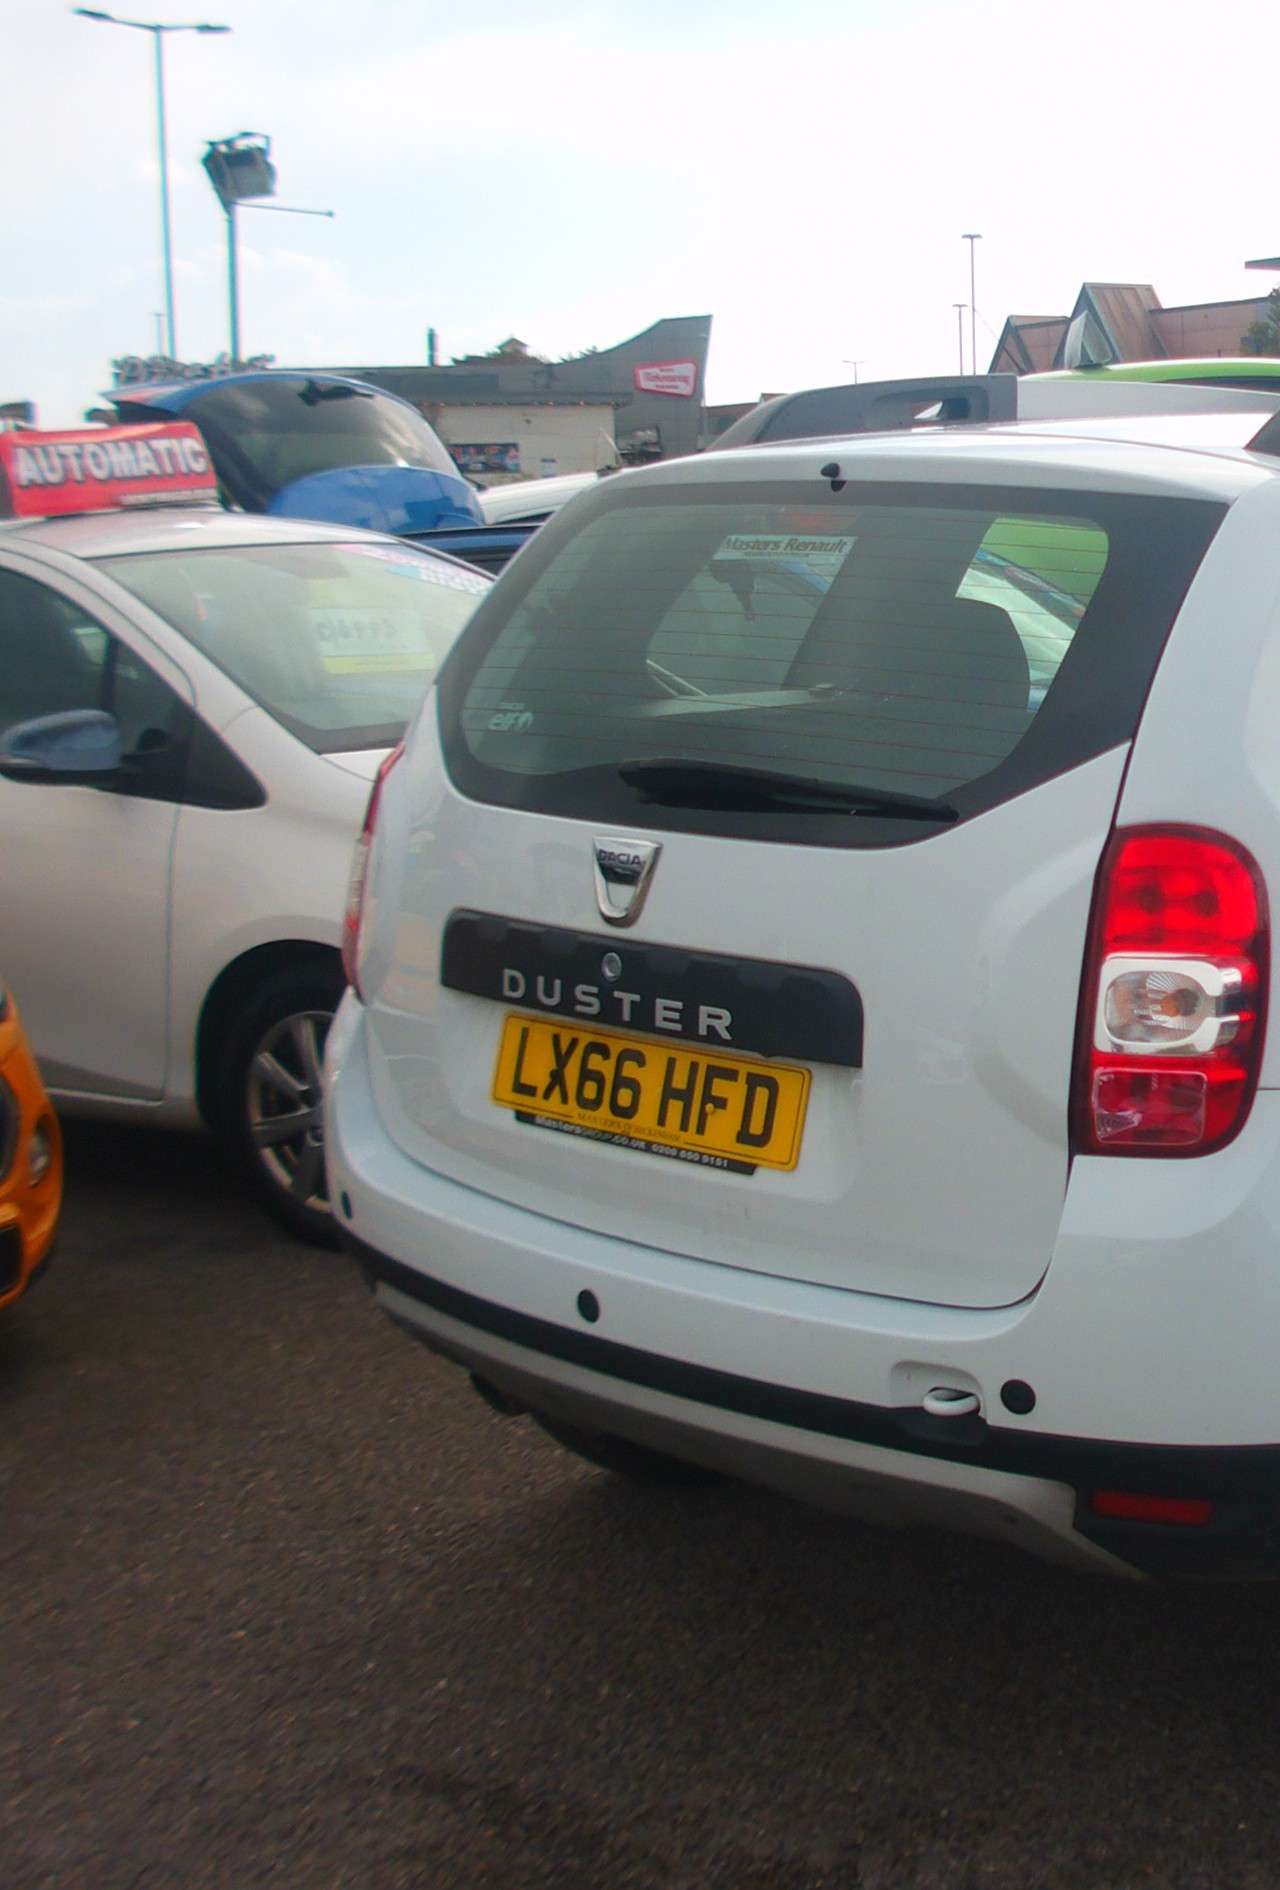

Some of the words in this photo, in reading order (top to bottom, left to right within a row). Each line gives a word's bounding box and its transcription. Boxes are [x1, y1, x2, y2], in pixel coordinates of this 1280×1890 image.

[17, 437, 210, 487] AUTOMATIC
[782, 537, 849, 553] Renault
[598, 848, 643, 867] DACIA
[502, 968, 733, 1041] DUSTER
[511, 1026, 647, 1120] LX66
[656, 1056, 780, 1149] HFD
